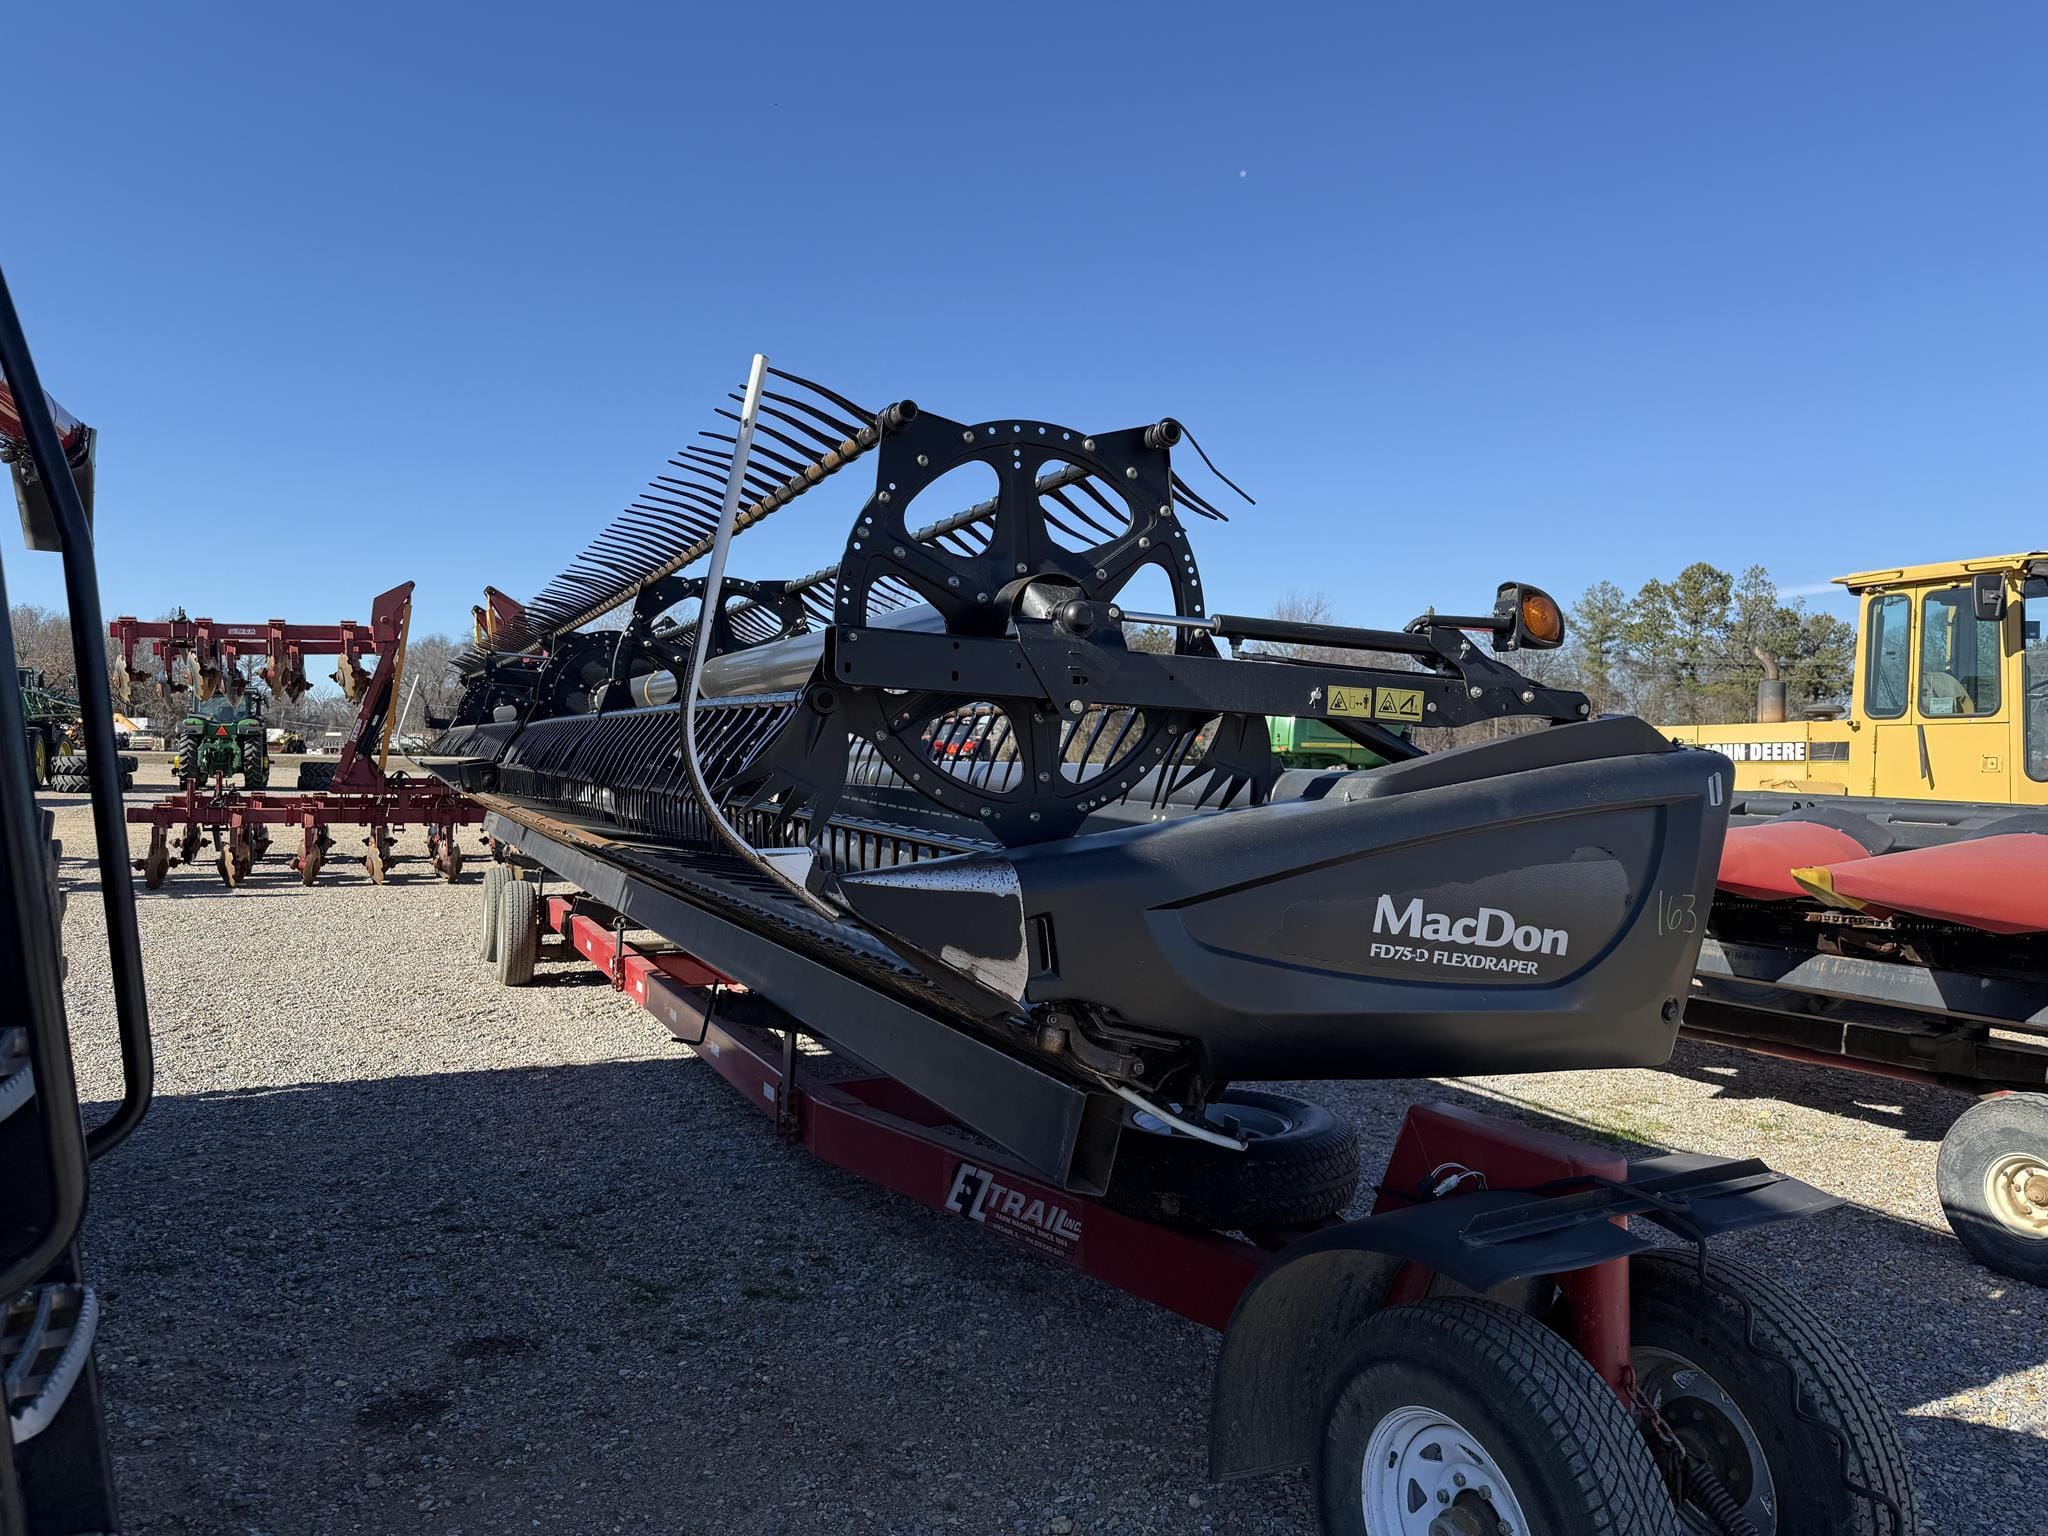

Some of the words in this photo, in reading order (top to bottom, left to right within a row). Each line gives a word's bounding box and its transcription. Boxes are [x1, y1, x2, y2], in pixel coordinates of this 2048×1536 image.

[1750, 742, 1805, 761] DEERE
[1373, 894, 1569, 956] MacDon
[1657, 890, 1697, 936] 163
[1433, 951, 1538, 976] FLEXDRAPER
[989, 1182, 1080, 1241] TRAIL
